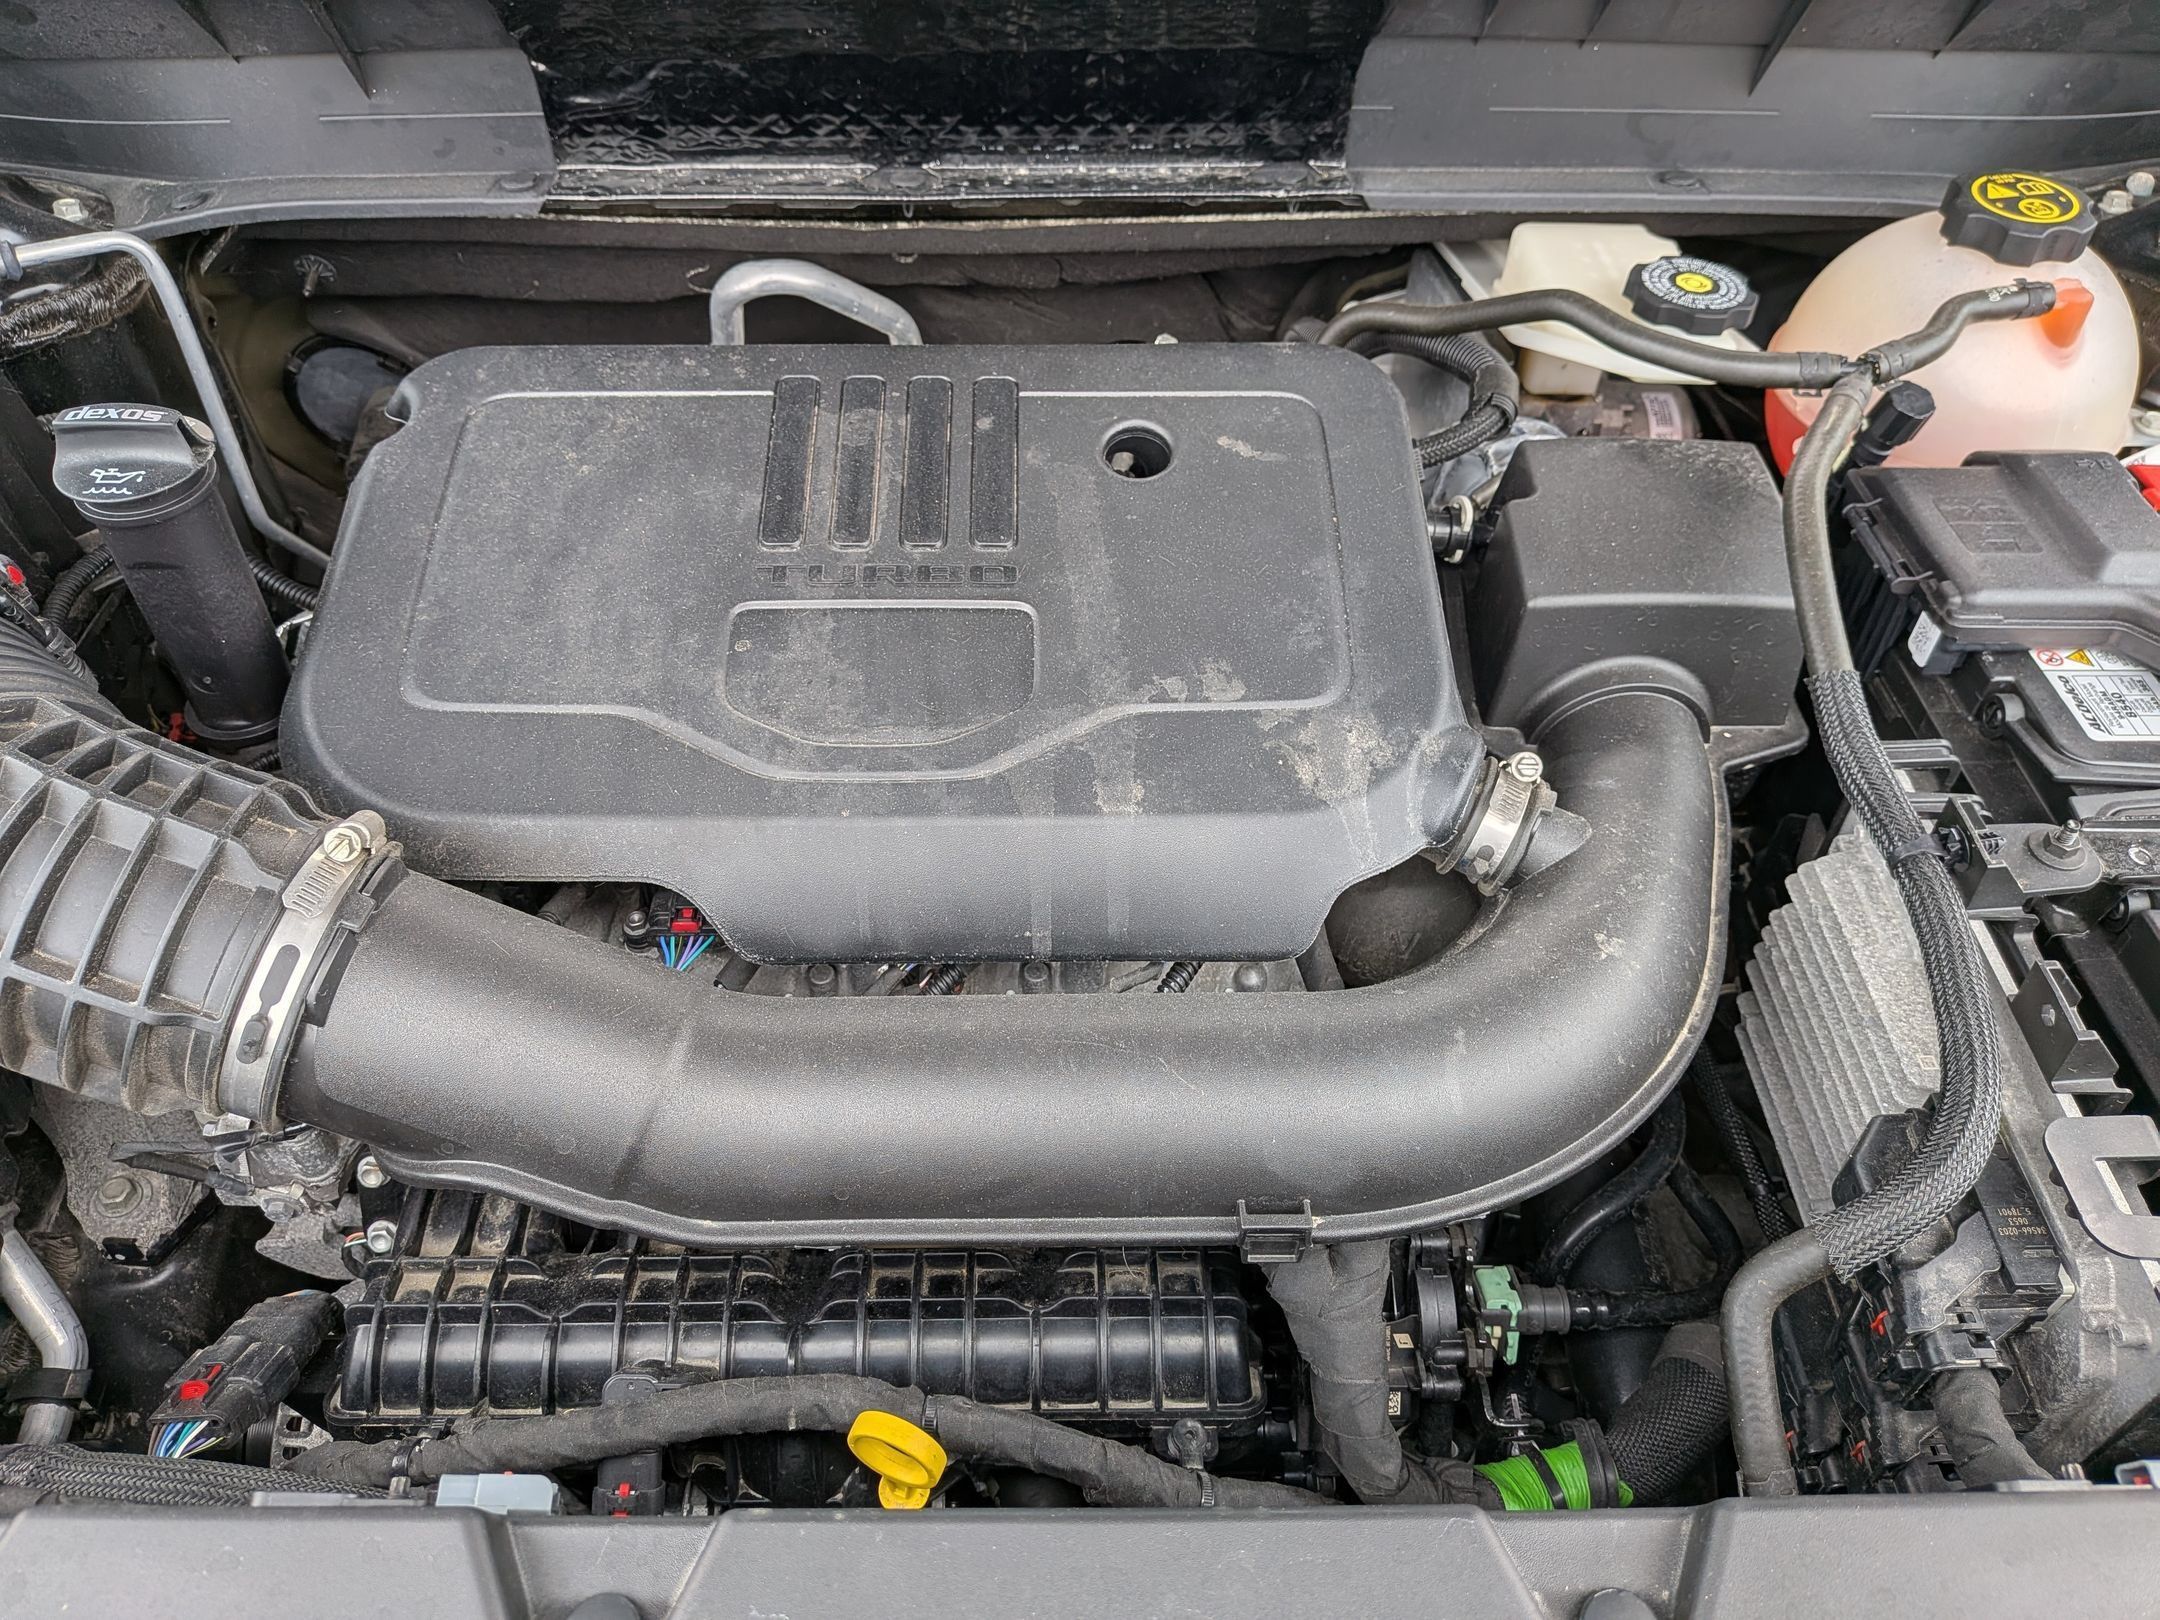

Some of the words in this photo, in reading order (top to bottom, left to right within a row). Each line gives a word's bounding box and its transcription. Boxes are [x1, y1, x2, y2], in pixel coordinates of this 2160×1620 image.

[64, 406, 165, 422] dexos
[755, 564, 1019, 585] TURBO
[2057, 675, 2106, 733] ACDelco
